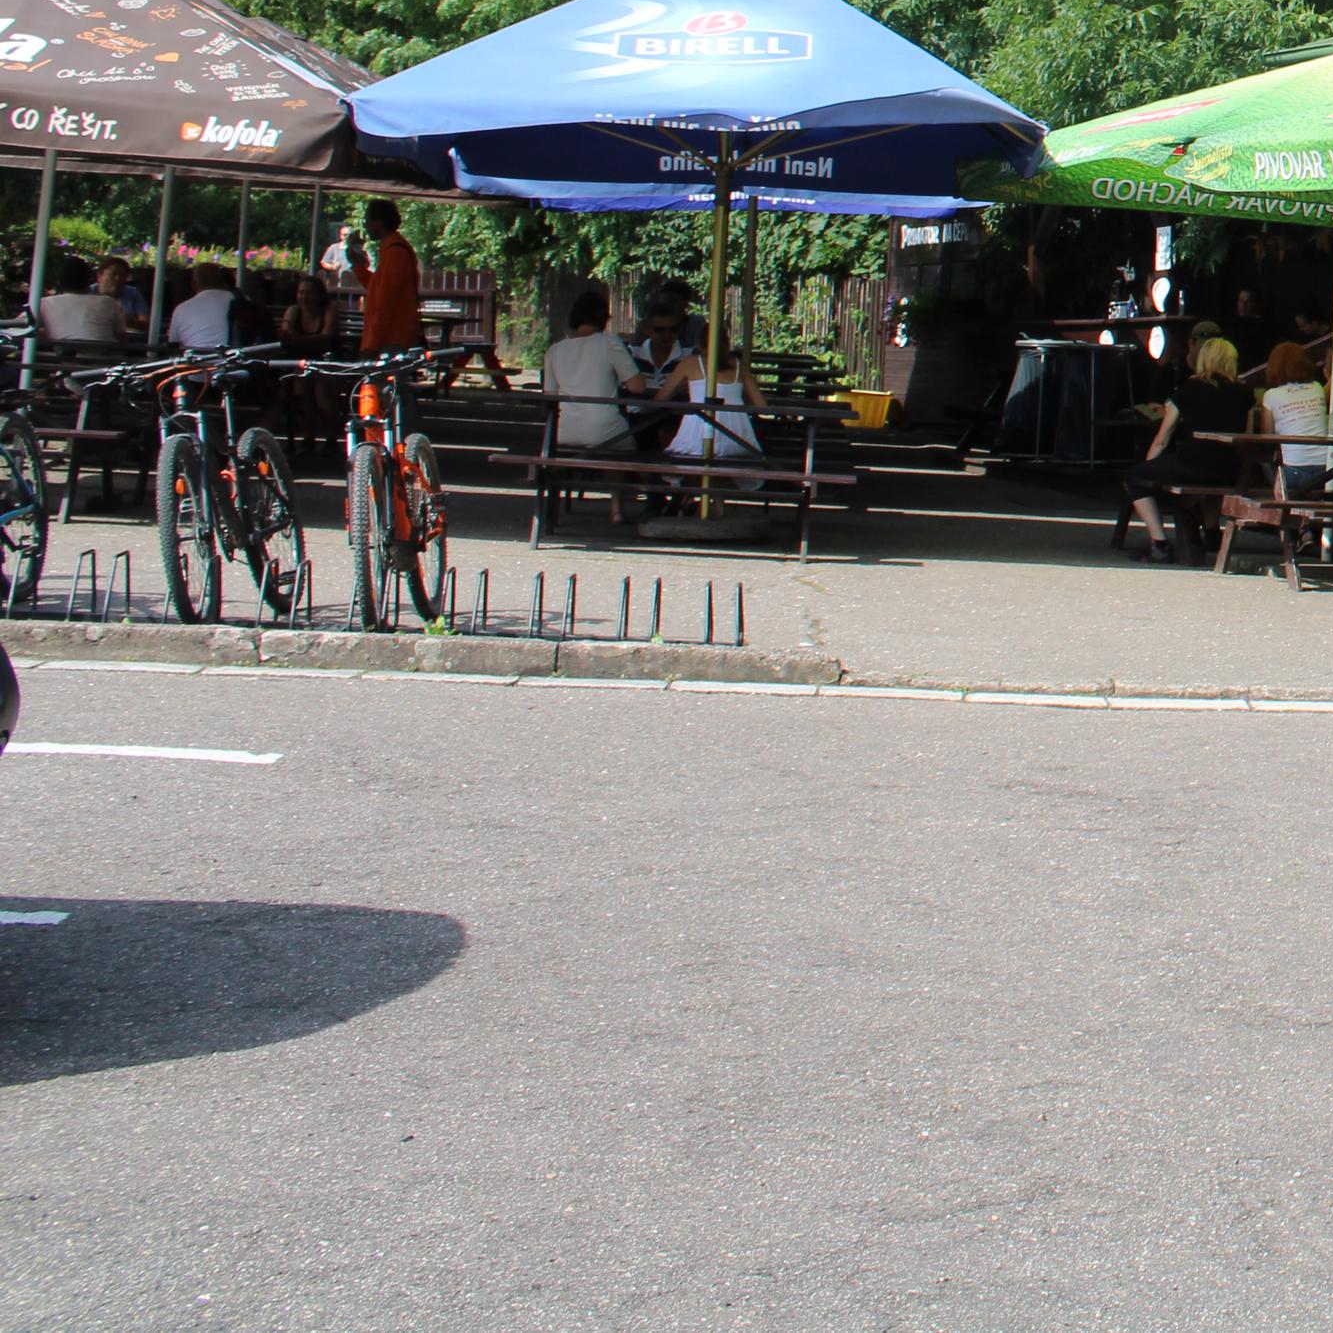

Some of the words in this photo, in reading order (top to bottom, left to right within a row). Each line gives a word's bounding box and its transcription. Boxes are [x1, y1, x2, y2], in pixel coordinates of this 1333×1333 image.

[635, 37, 790, 55] BIRELL
[11, 107, 39, 130] CO
[48, 105, 118, 140] ŘEŠIT.
[200, 116, 279, 151] kofola
[1254, 151, 1327, 180] PIVOVAR
